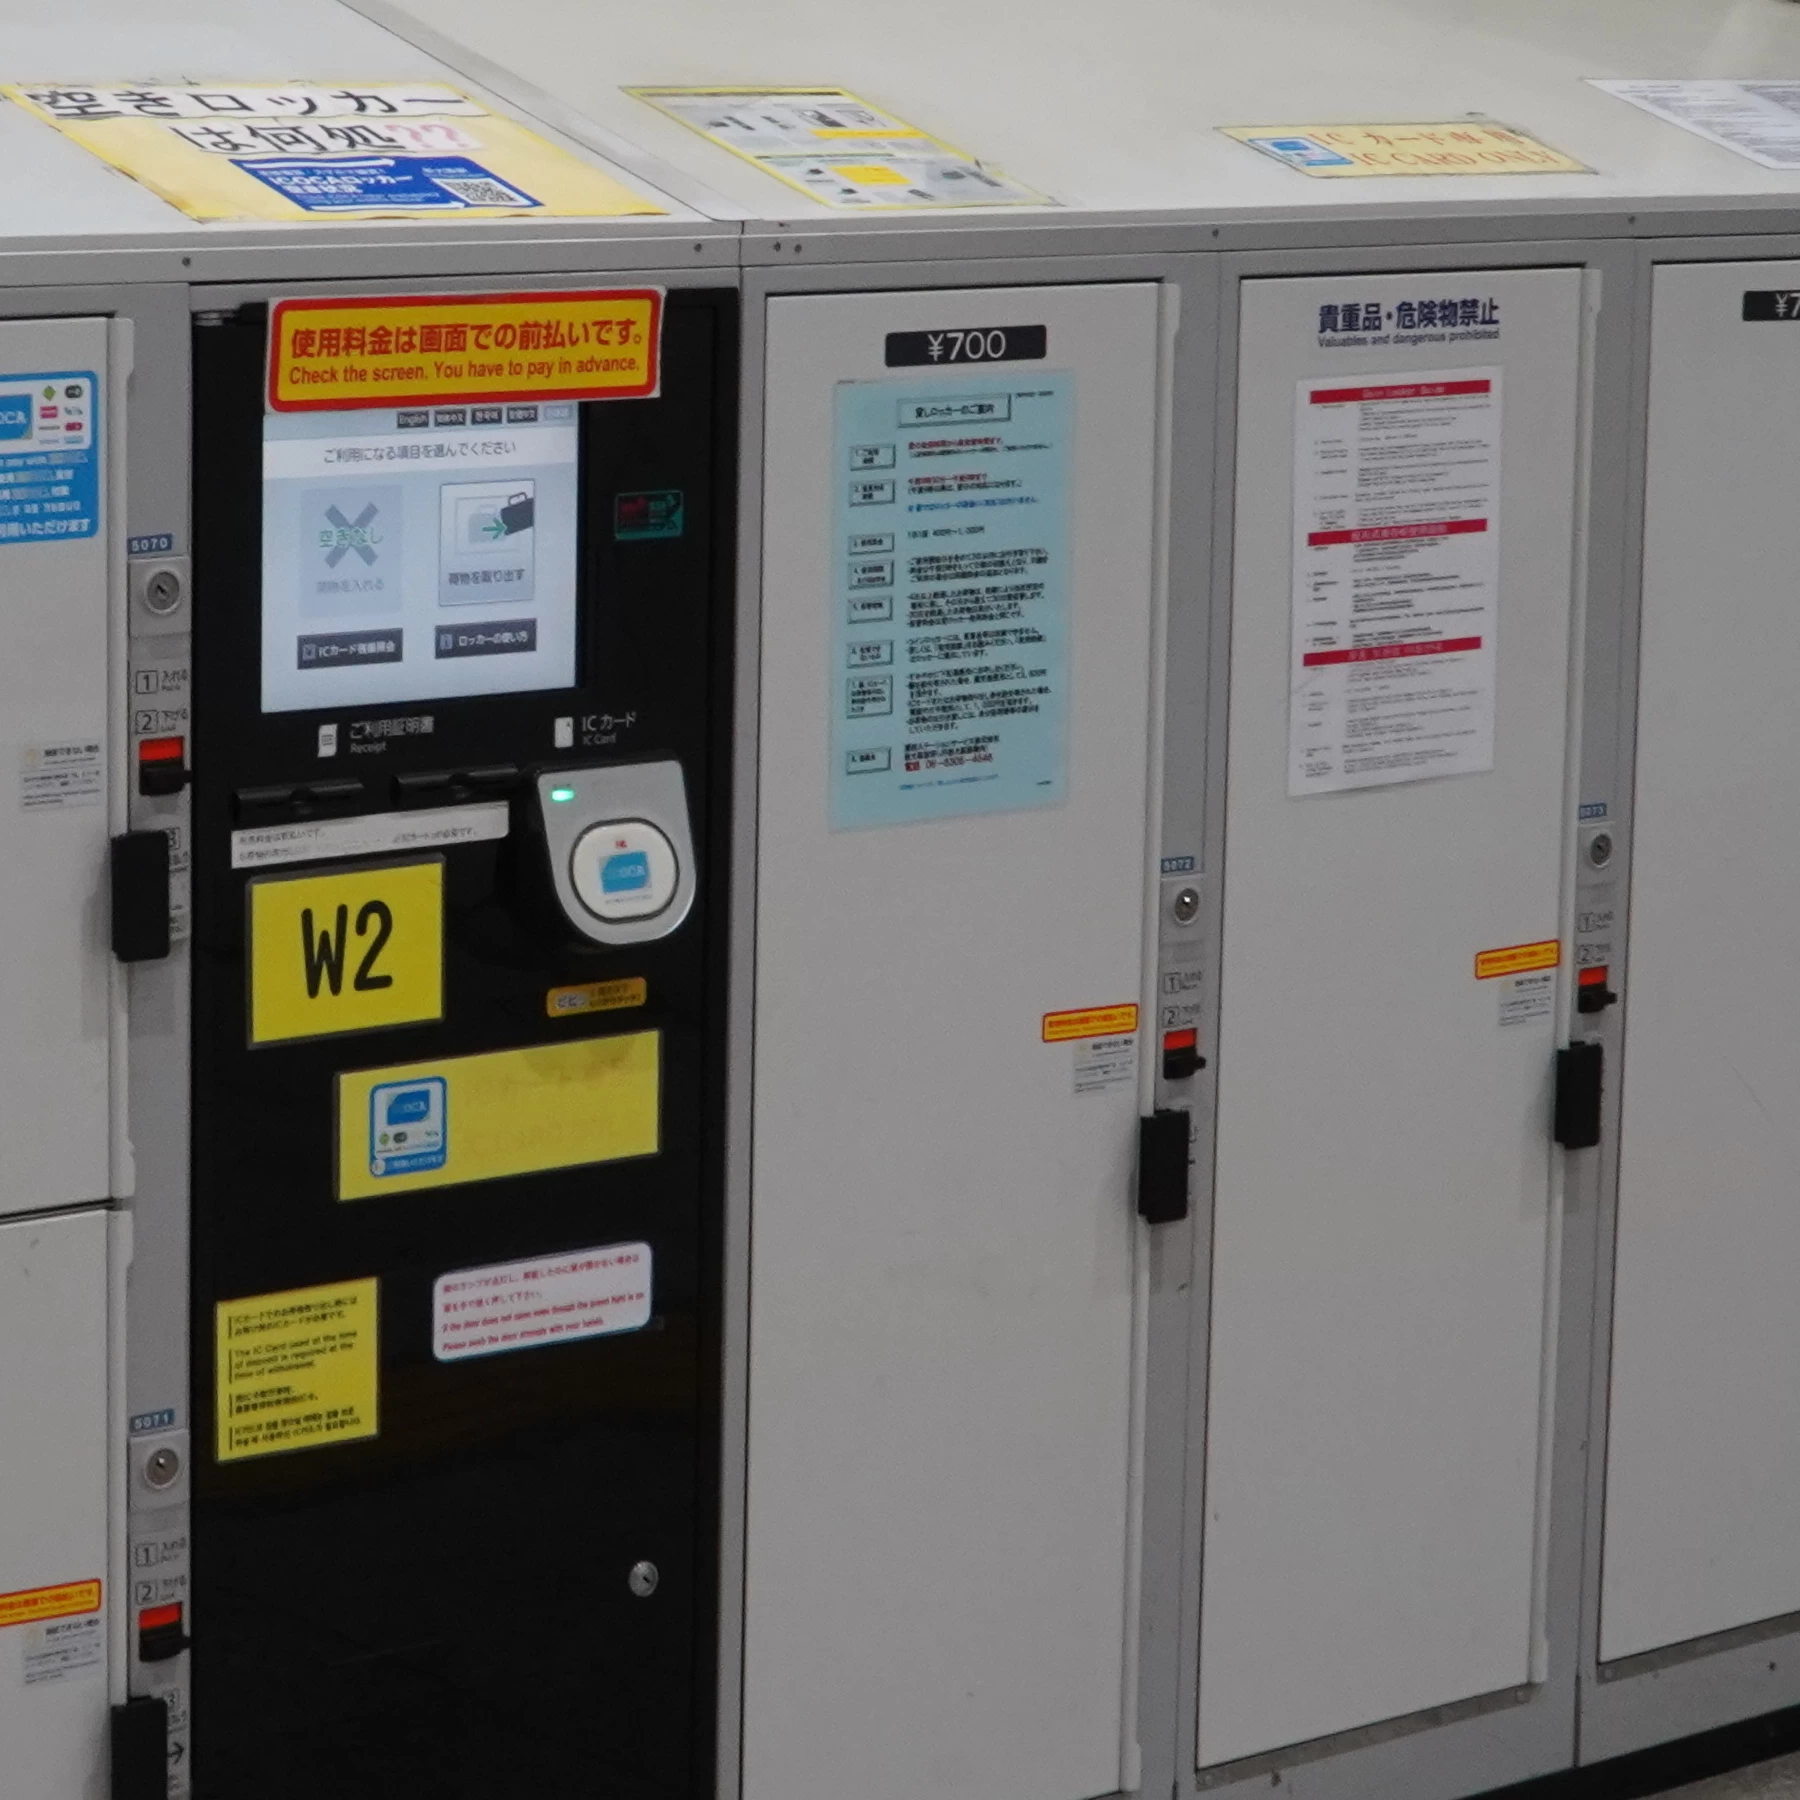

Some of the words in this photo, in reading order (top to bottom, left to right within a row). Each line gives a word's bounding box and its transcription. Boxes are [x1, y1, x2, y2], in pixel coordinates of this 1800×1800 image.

[27, 89, 466, 118] 空きロッカー
[1318, 297, 1500, 334] 貴重品・危険物禁止
[291, 318, 643, 358] 使用料金は画面での前払いです。
[928, 330, 1006, 361] ¥700
[289, 366, 338, 385] Check
[343, 364, 367, 382] the
[372, 364, 429, 380] screen.
[434, 361, 463, 379] You
[467, 360, 505, 378] have
[508, 360, 523, 376] to
[526, 360, 554, 380] pay
[559, 357, 572, 374] in
[576, 356, 641, 373] advance.
[301, 900, 394, 1000] W2
